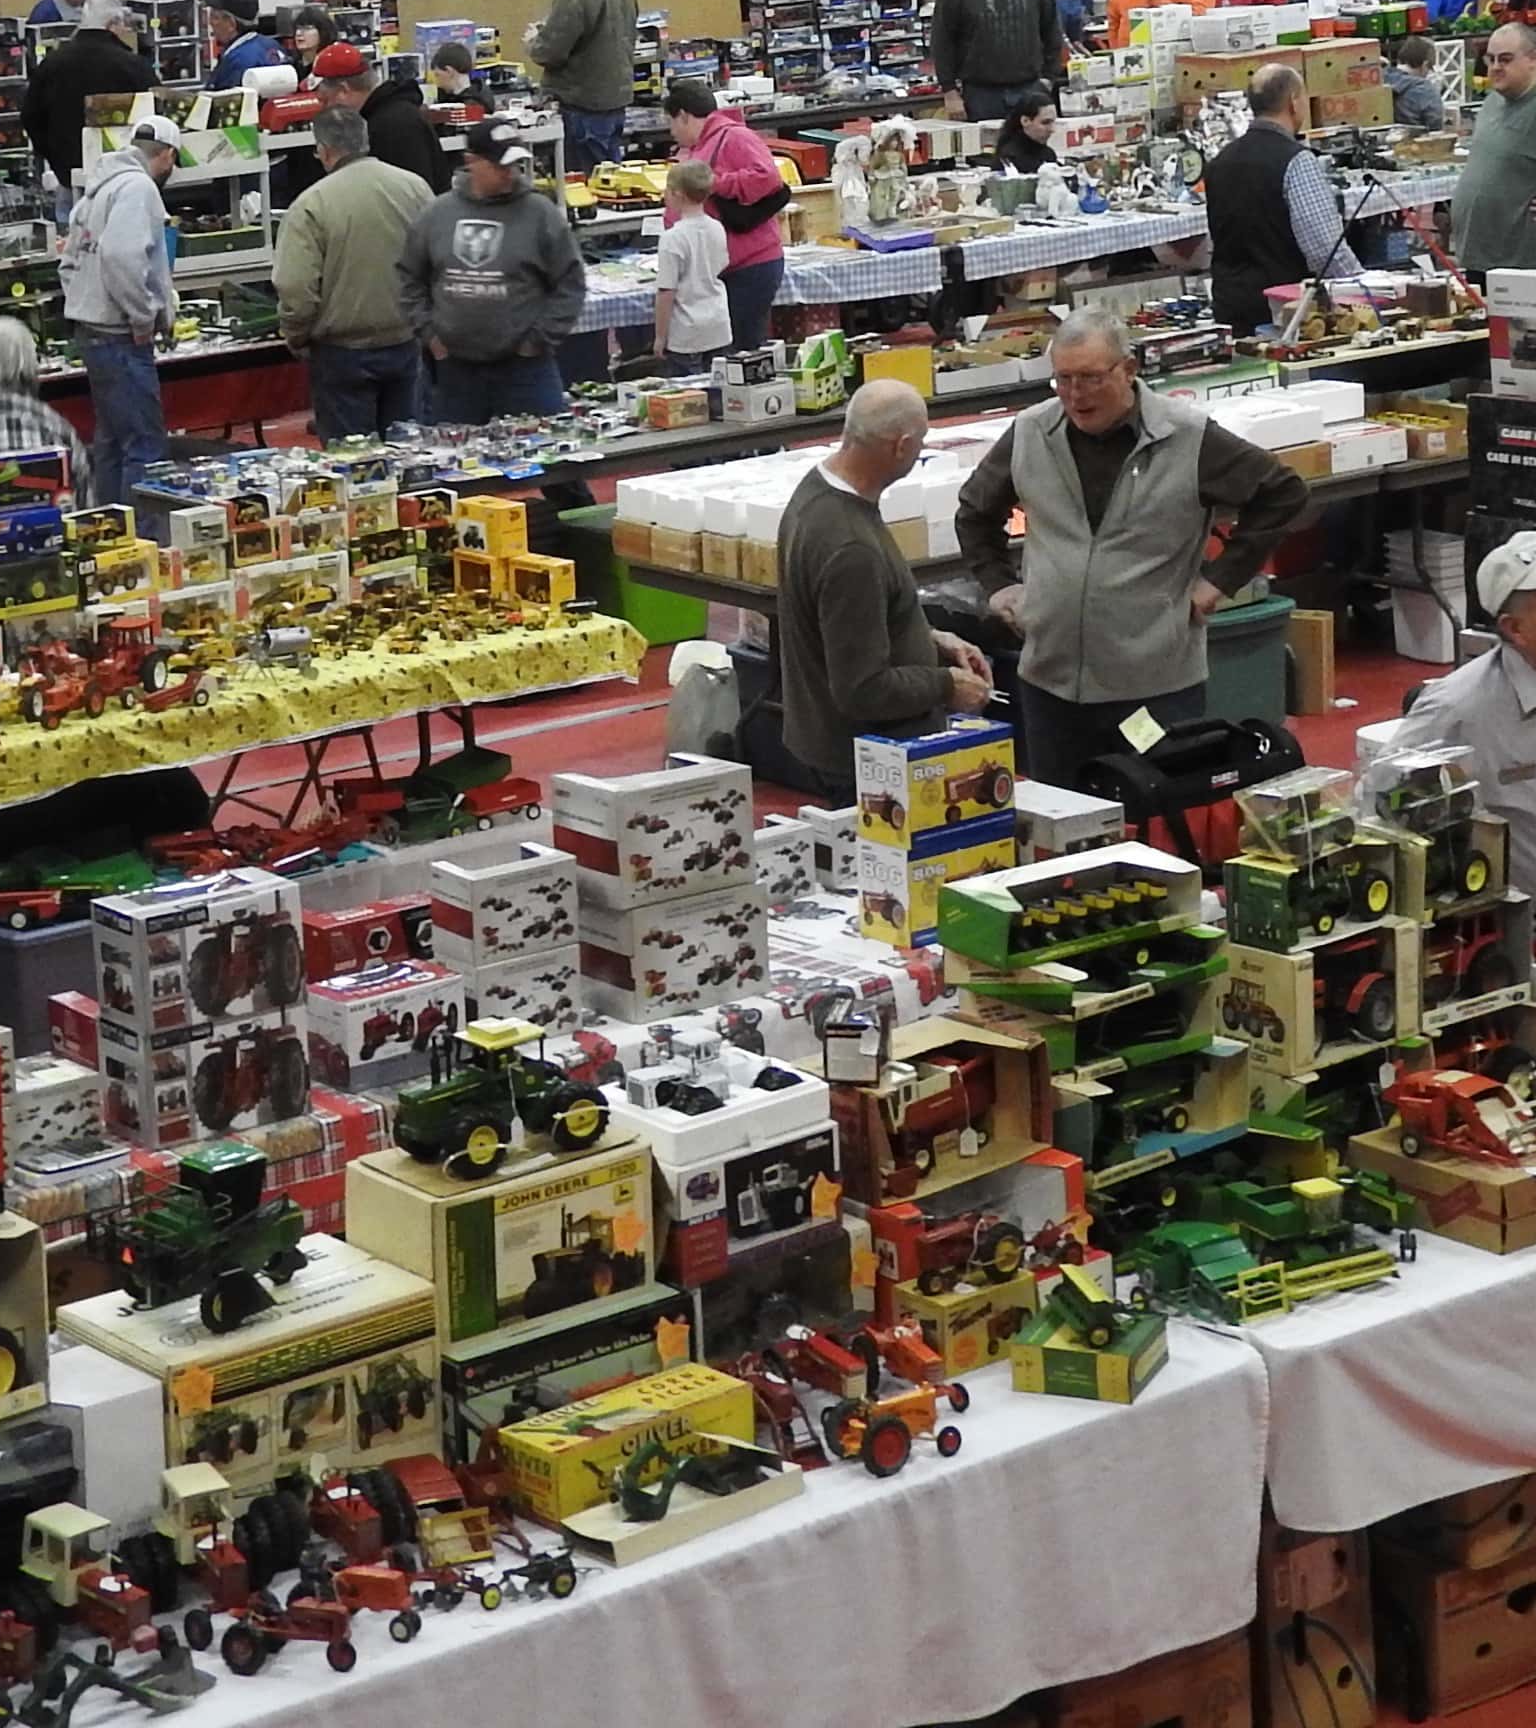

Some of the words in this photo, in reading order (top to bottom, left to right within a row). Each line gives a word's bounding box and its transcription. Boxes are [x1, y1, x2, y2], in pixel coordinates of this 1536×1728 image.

[1501, 428, 1531, 440] CASE
[1486, 451, 1510, 464] CASE
[861, 762, 903, 787] 806
[913, 763, 946, 782] 806
[862, 860, 904, 887] 806
[912, 864, 946, 882] 806
[502, 1189, 540, 1210] JOHN
[544, 1176, 591, 1197] DEERE
